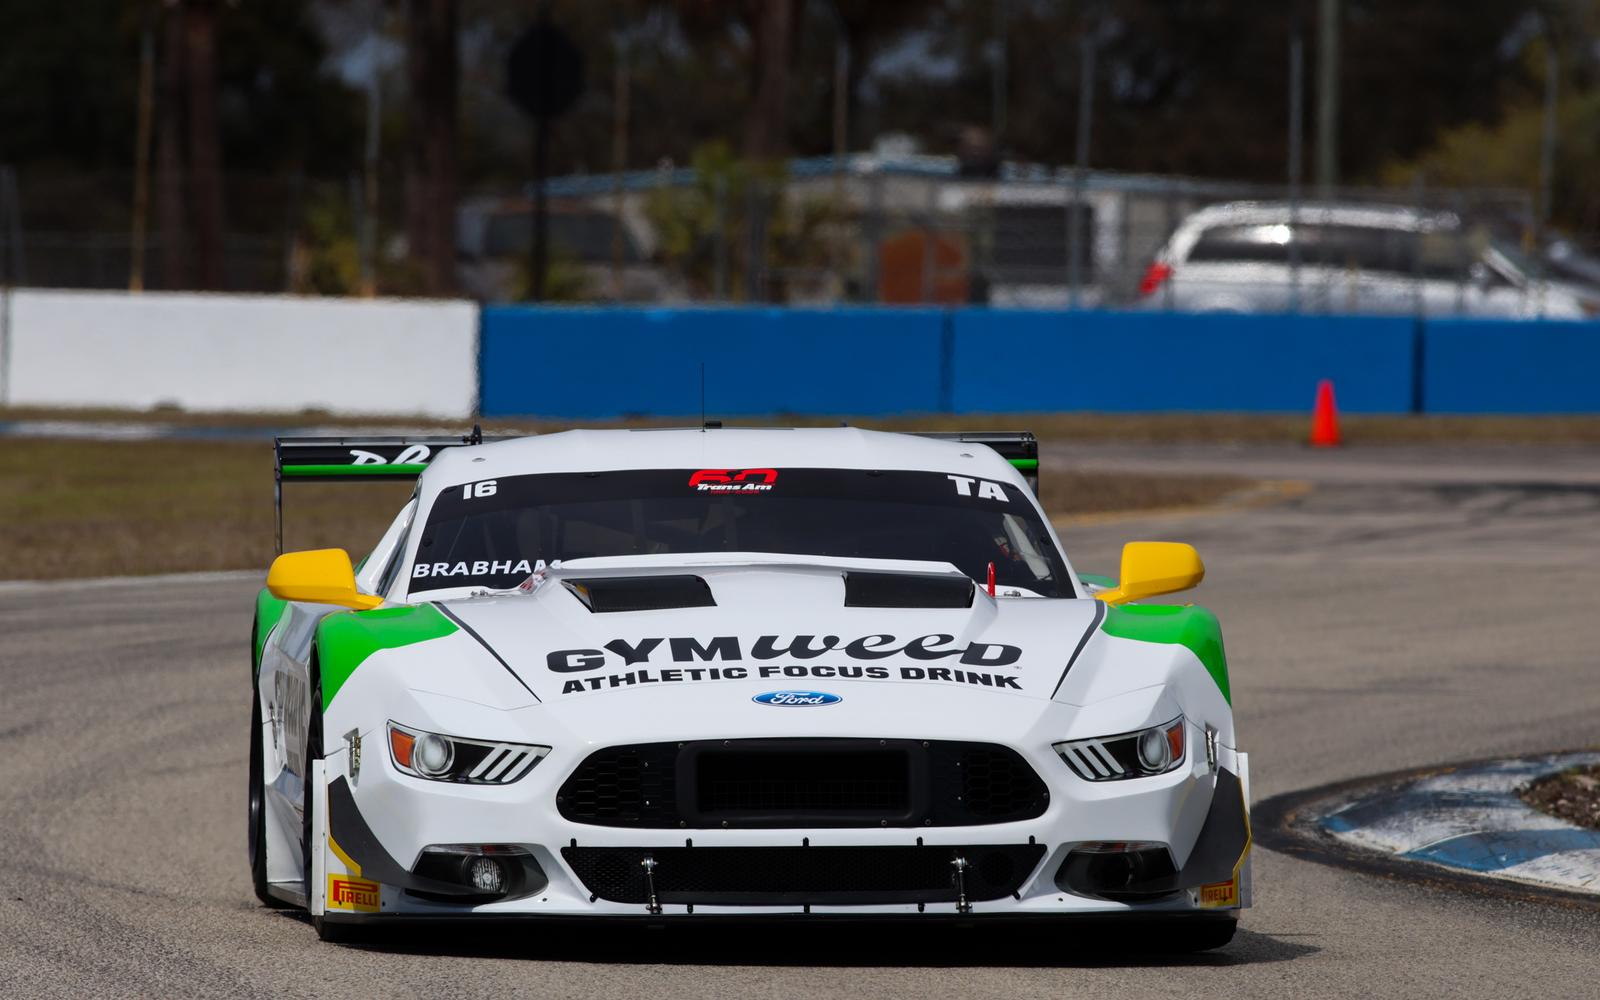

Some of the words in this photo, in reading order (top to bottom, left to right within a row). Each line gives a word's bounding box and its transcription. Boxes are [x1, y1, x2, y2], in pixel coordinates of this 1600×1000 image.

[463, 480, 497, 500] 16
[697, 483, 740, 491] Trans
[741, 483, 772, 491] Am
[947, 474, 1010, 502] TA
[562, 667, 748, 694] ATHLETIC
[759, 665, 890, 679] FOCUS
[900, 667, 1024, 690] DRINK
[770, 691, 825, 704] Ford
[333, 880, 378, 907] PIRELLI
